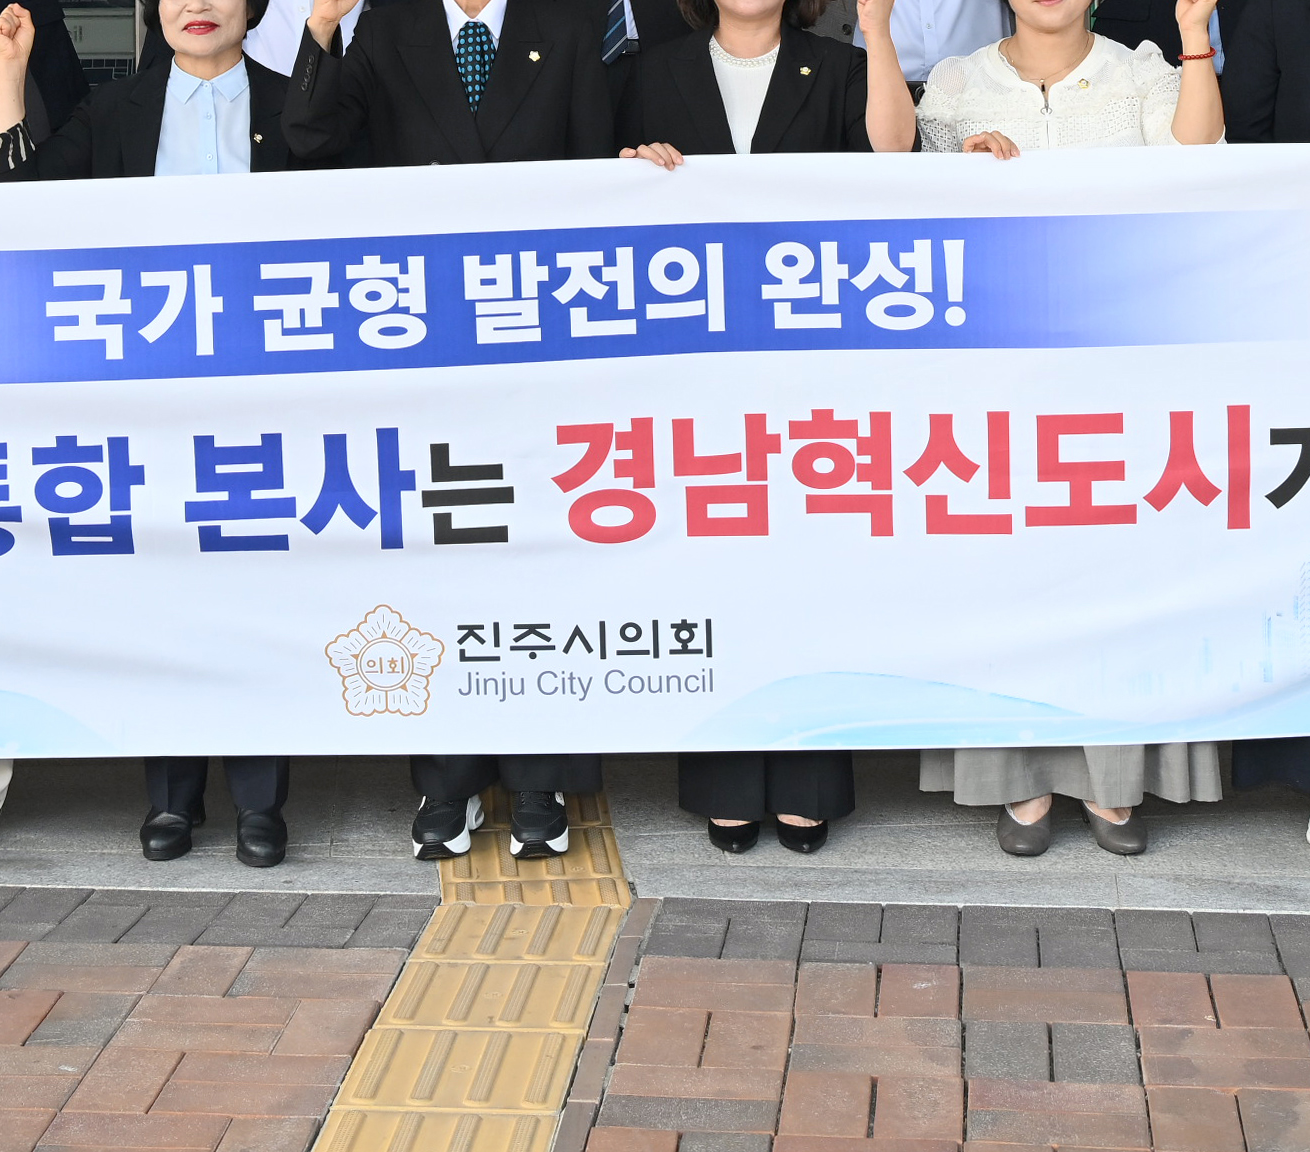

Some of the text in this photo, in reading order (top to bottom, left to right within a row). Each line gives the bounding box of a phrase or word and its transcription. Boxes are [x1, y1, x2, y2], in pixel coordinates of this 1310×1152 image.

[45, 238, 967, 361] 국가 균형 발전의 완성!
[184, 427, 514, 552] 본사는
[456, 619, 713, 662] 진주시의회
[365, 656, 405, 674] 의회
[458, 669, 714, 702] Jinju City Council
